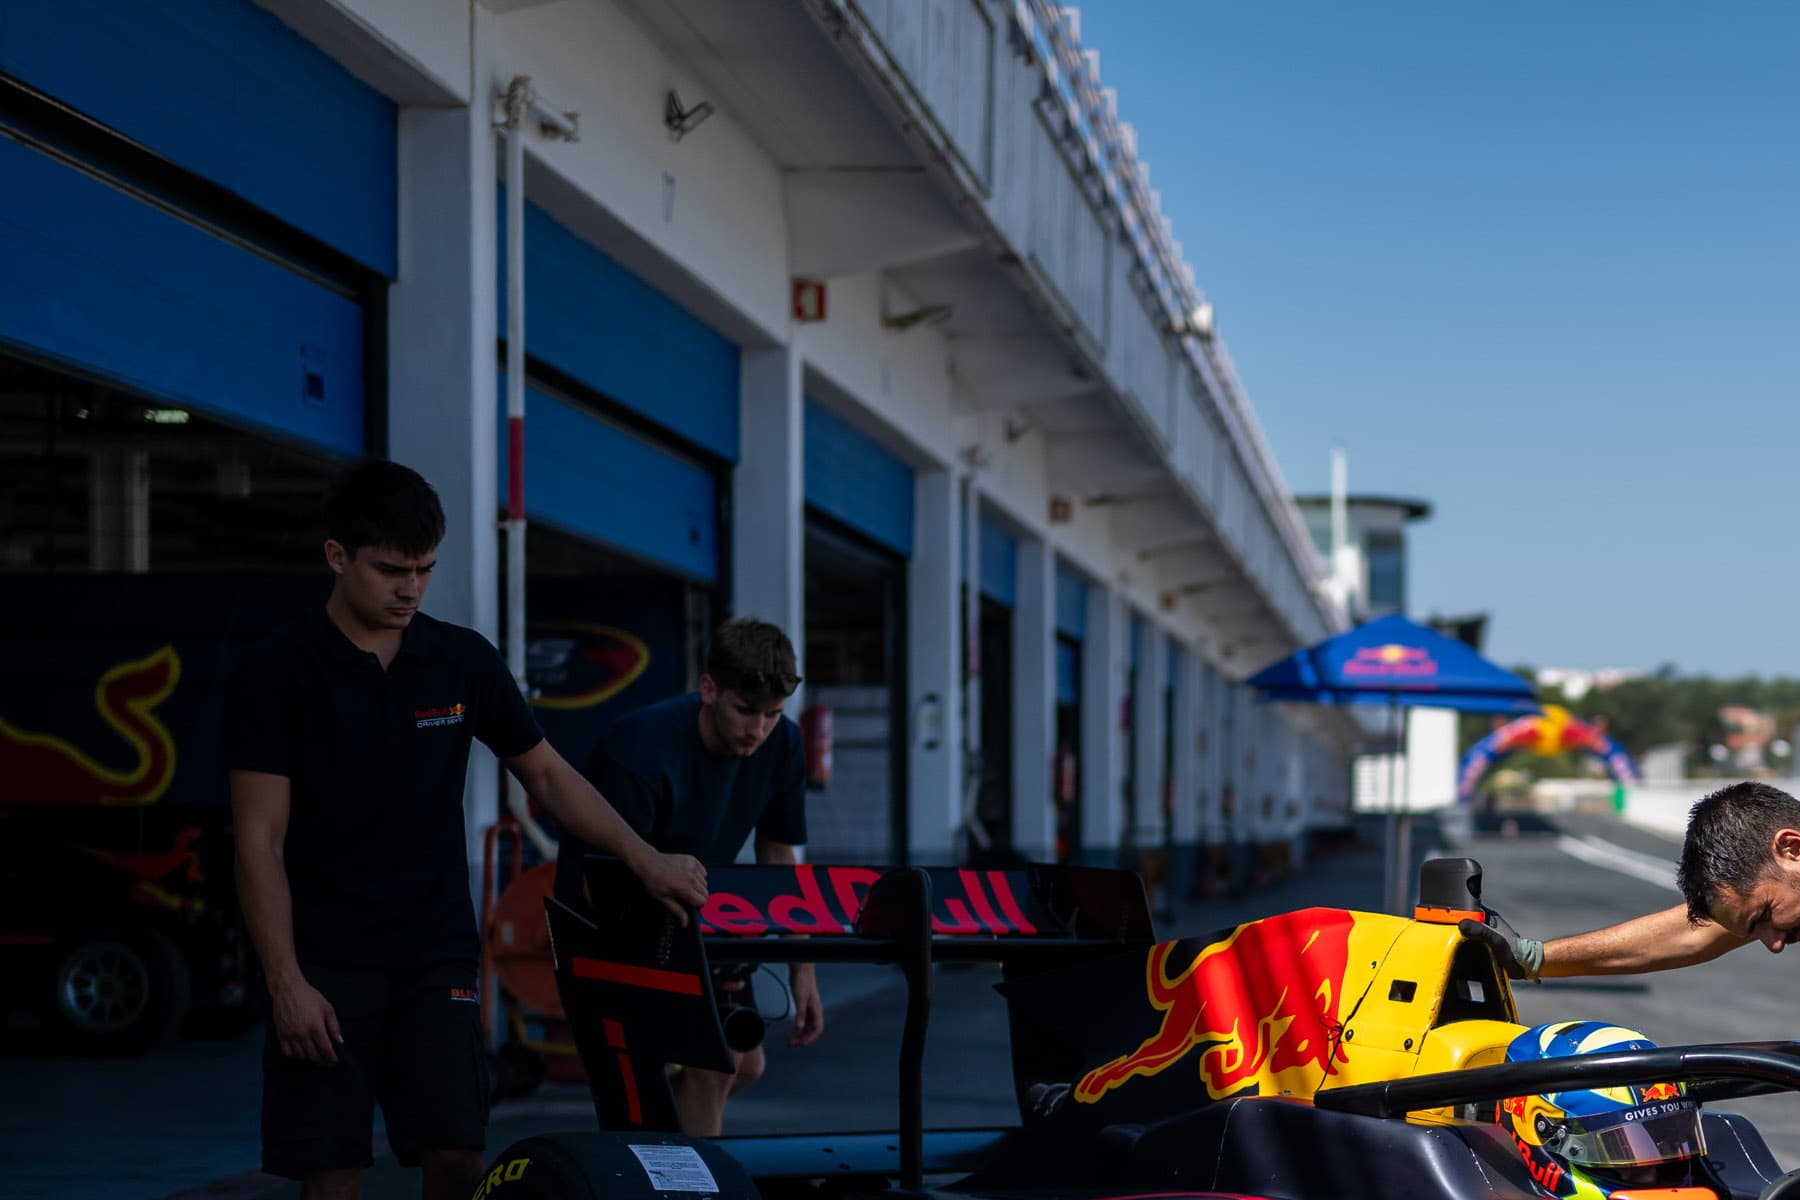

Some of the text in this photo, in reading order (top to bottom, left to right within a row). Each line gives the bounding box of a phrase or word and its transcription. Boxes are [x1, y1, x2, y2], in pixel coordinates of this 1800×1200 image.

[700, 864, 849, 935] ed
[1625, 1106, 1658, 1121] GIVES
[1661, 1101, 1680, 1113] YOU
